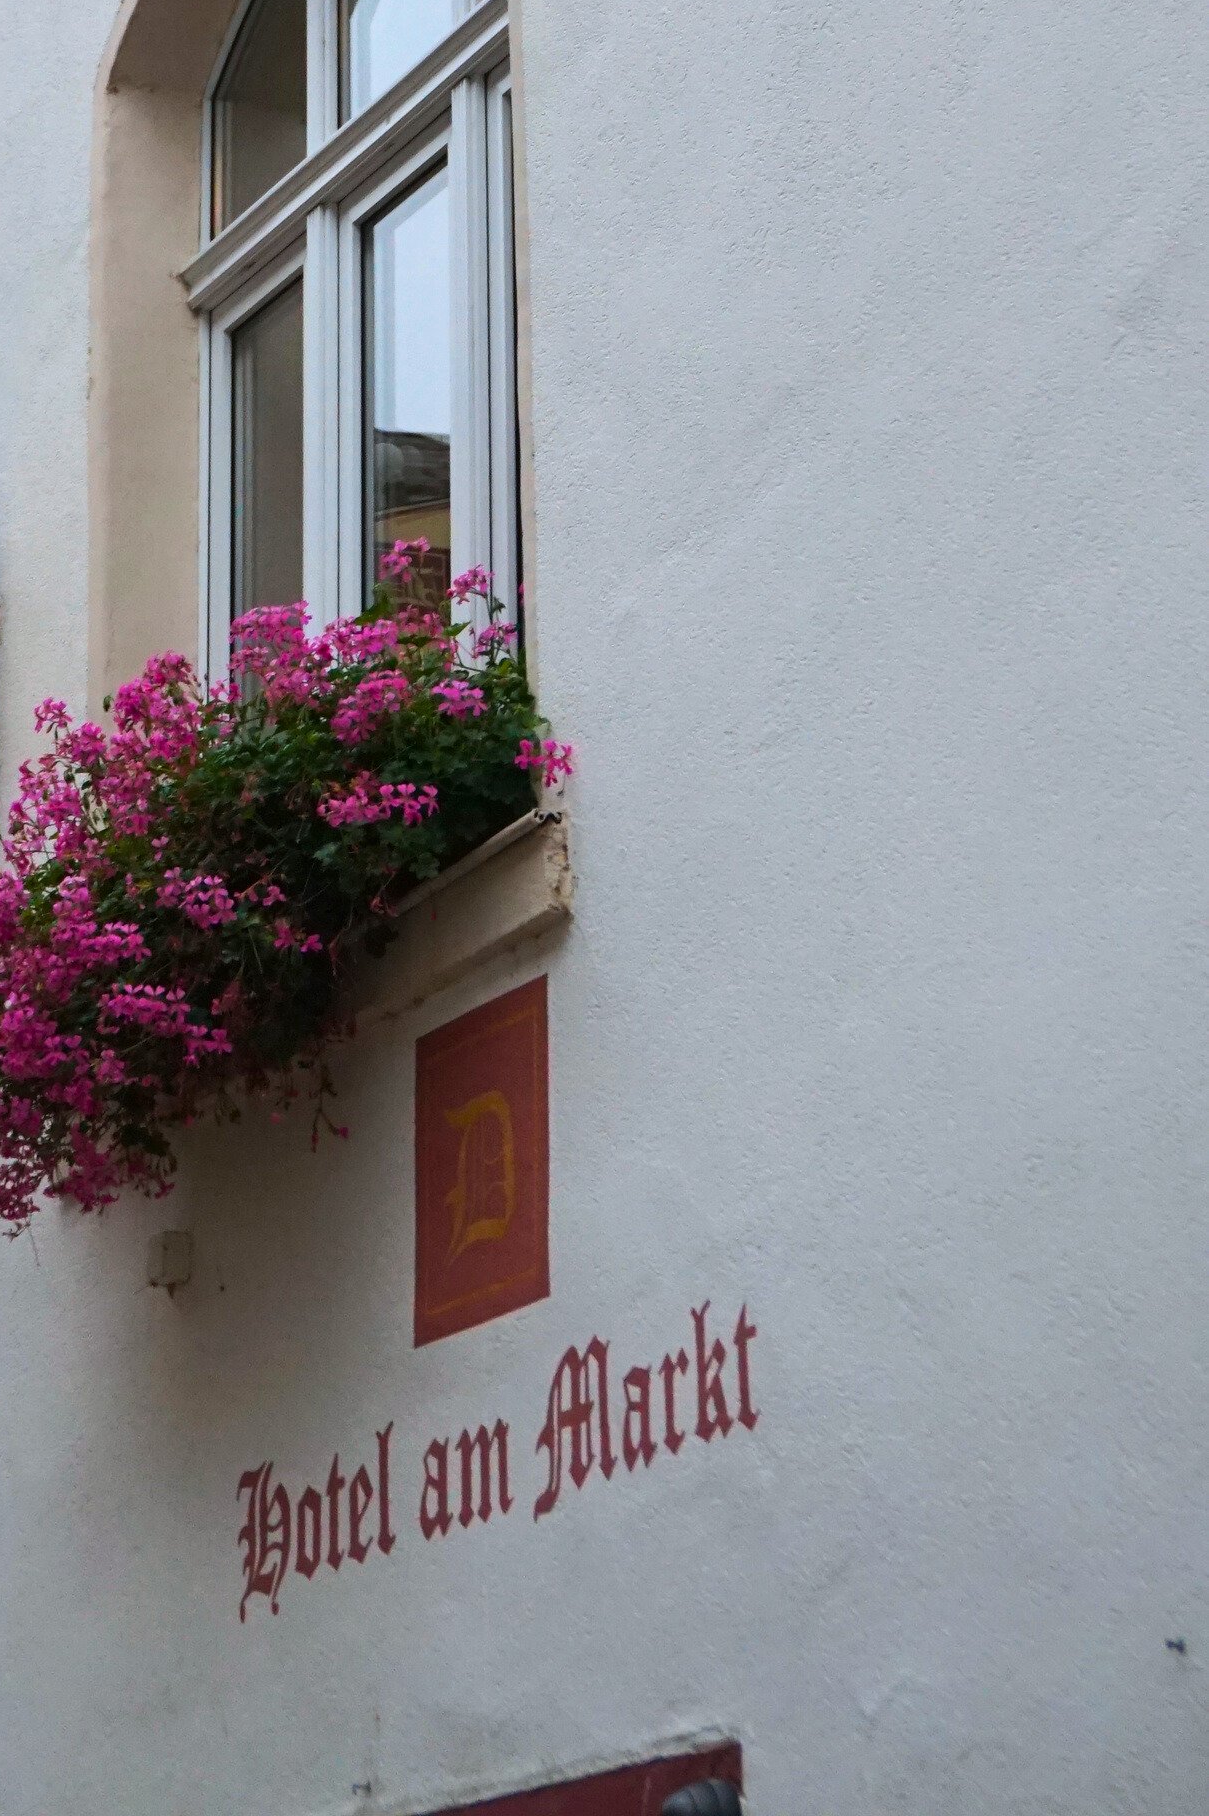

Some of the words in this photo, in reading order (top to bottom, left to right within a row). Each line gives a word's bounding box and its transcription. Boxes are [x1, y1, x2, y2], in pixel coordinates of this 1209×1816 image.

[443, 1089, 517, 1269] D
[236, 1420, 397, 1624] Hotel
[419, 1416, 515, 1542] am
[533, 1298, 761, 1522] Markt
